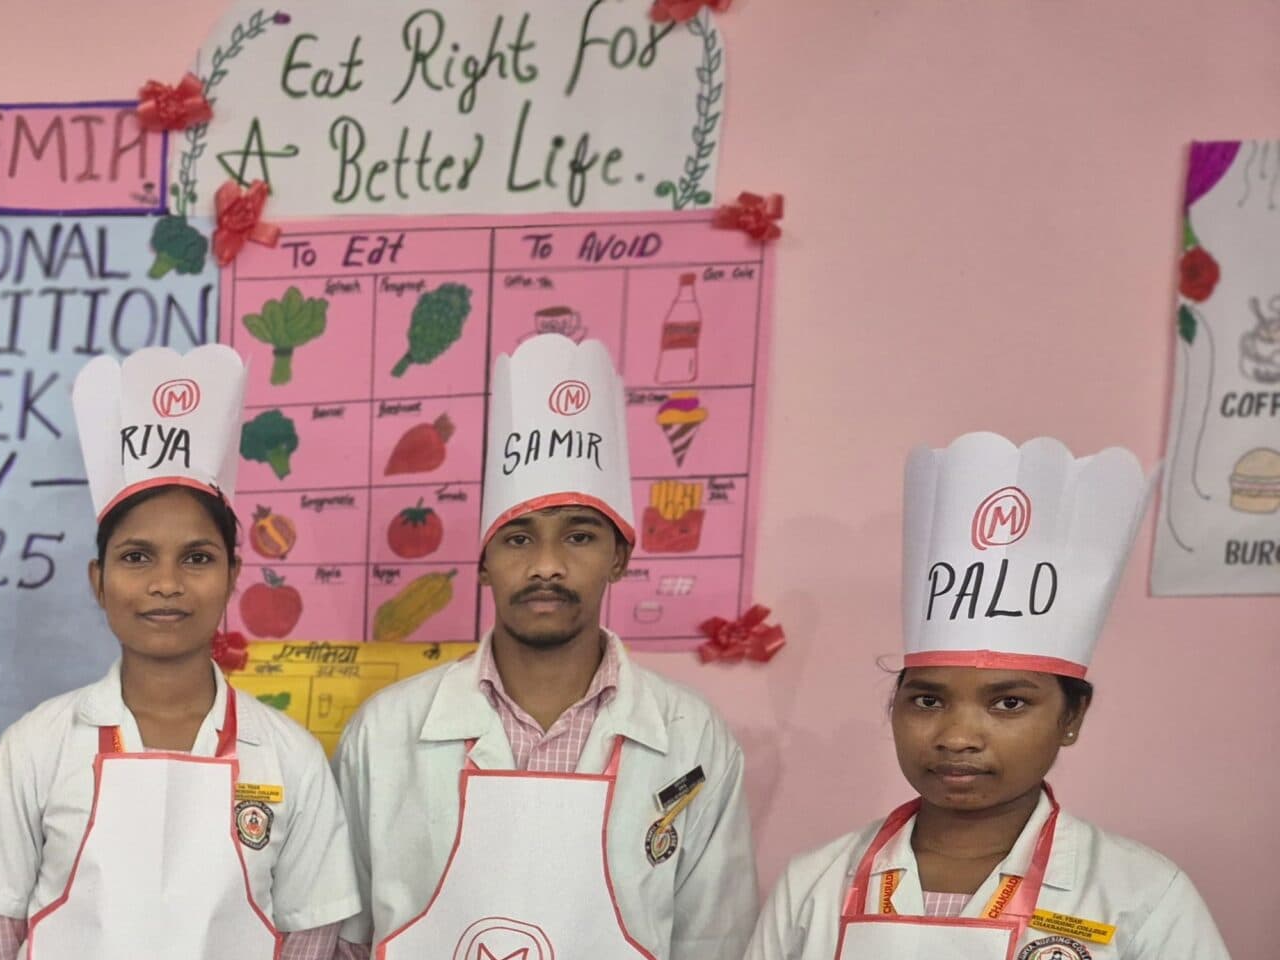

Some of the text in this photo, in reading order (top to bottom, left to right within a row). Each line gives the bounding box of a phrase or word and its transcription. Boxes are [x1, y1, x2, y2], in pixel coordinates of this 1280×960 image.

[280, 34, 363, 99] Eat
[392, 9, 538, 115] Right
[329, 115, 484, 203] Better
[280, 232, 405, 269] To Eat
[578, 231, 663, 263] AVOID
[121, 424, 191, 468] RIYA
[503, 429, 603, 475] SAMIR
[927, 558, 1058, 621] PALO
